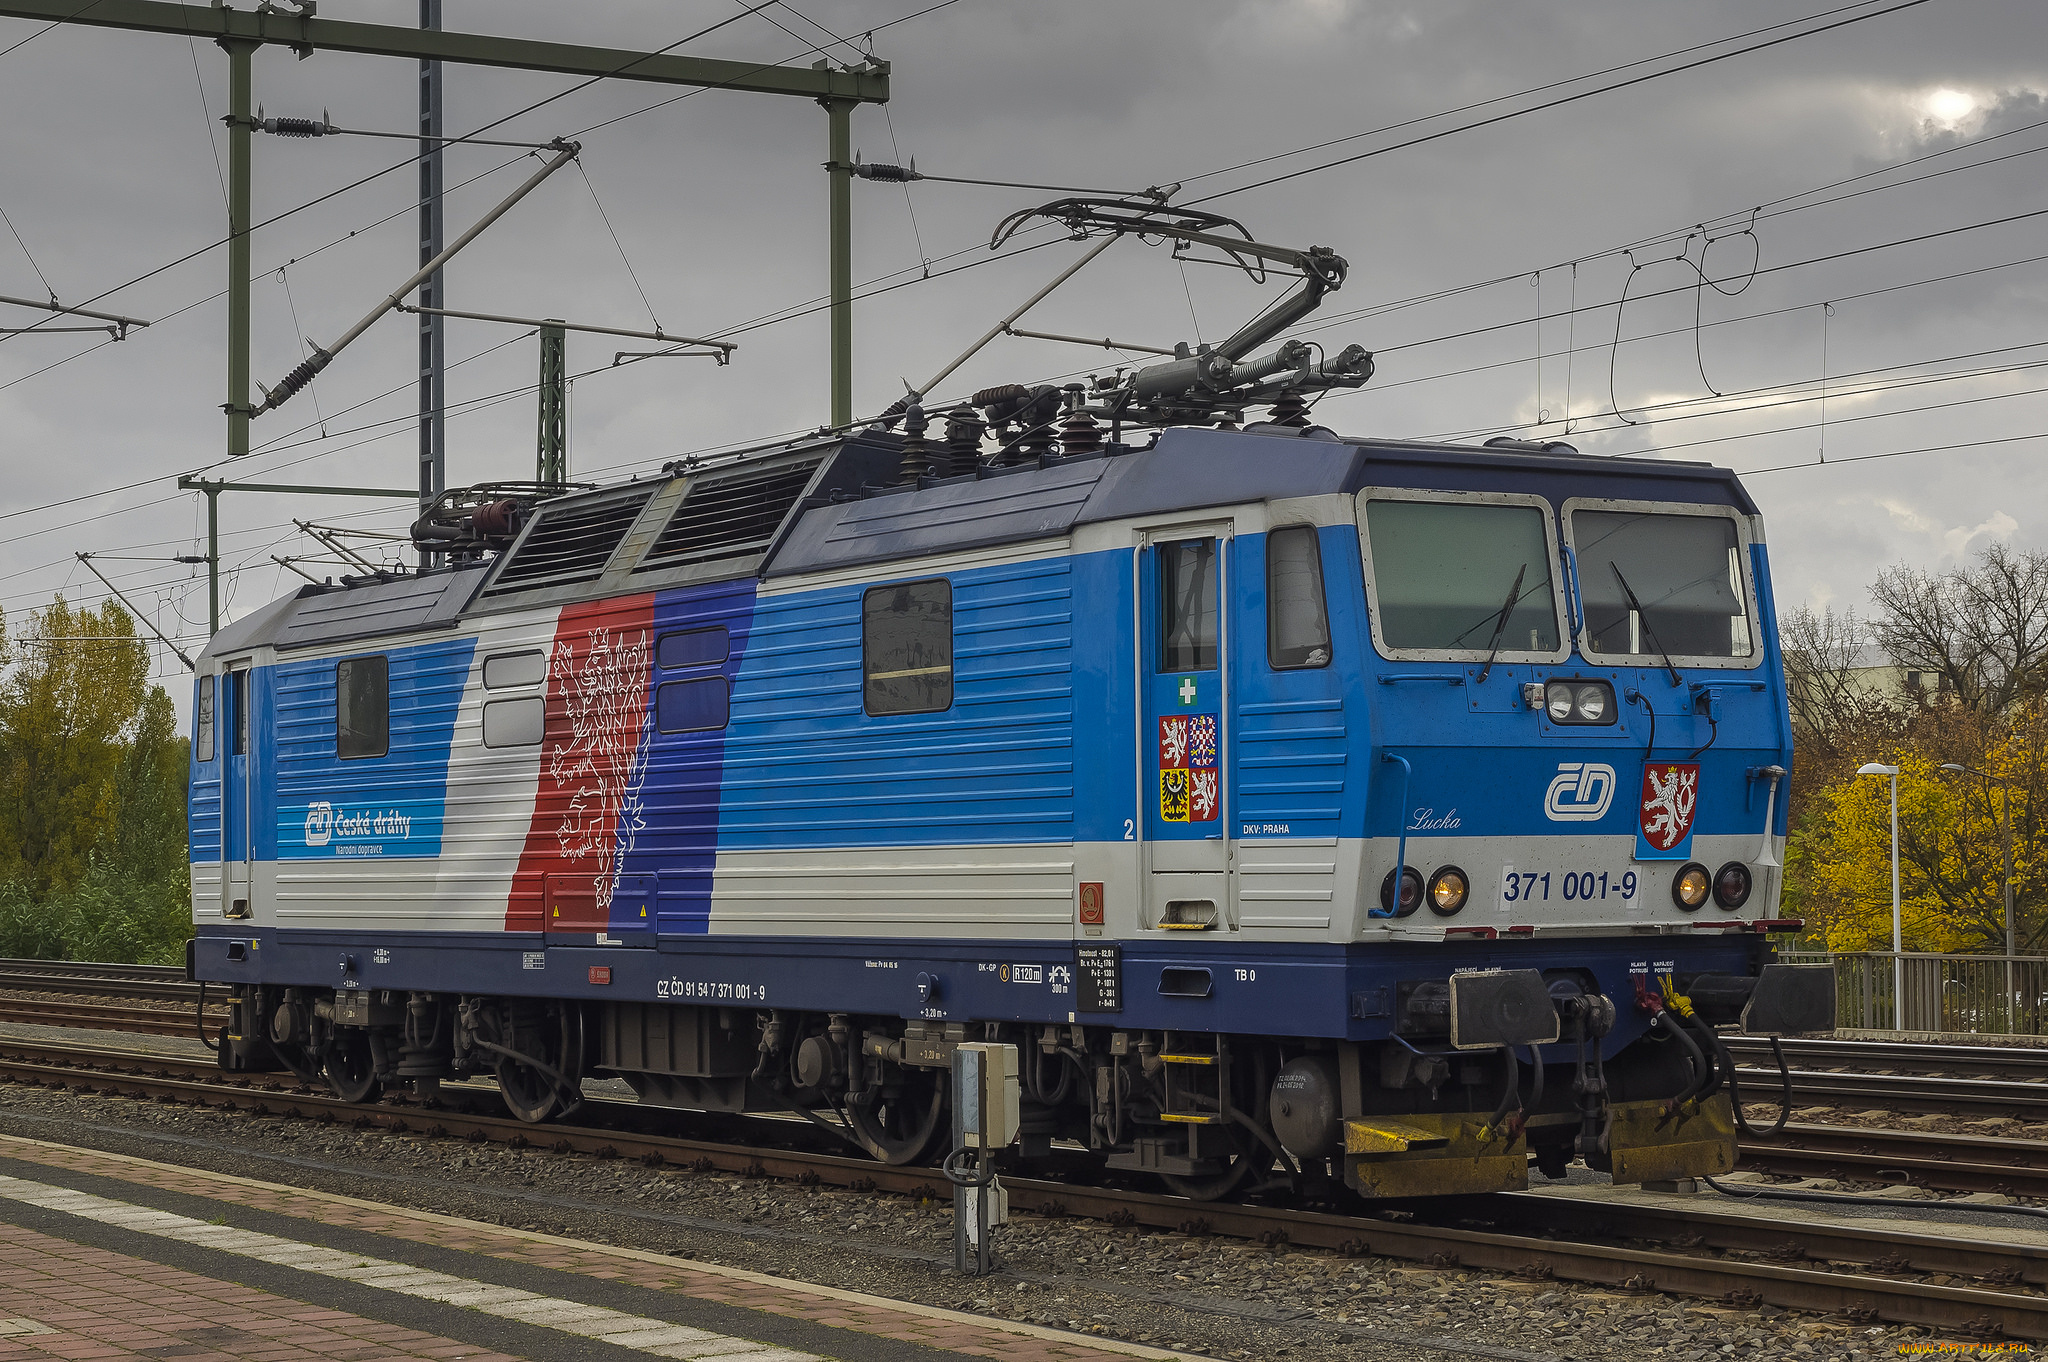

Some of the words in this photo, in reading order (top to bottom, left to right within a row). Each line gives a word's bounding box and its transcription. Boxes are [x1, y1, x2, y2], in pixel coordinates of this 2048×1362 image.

[335, 808, 370, 836] České
[374, 808, 412, 840] dráhy
[1406, 808, 1462, 830] Lucka
[1124, 818, 1134, 840] 2
[1243, 824, 1260, 834] DKV:
[1262, 824, 1290, 834] PRAHA
[358, 844, 383, 856] dopravce
[1504, 872, 1551, 902] 371
[1562, 871, 1638, 900] 001-9
[1234, 969, 1247, 981] TB
[657, 980, 669, 997] CZ
[671, 976, 684, 995] ČD
[686, 982, 695, 996] 91
[698, 982, 708, 997] 54
[711, 983, 716, 997] 7
[718, 983, 733, 998] 371
[735, 984, 750, 999] 001
[760, 985, 765, 1000] 9
[1051, 984, 1062, 994] 300
[925, 1008, 936, 1018] 3,20
